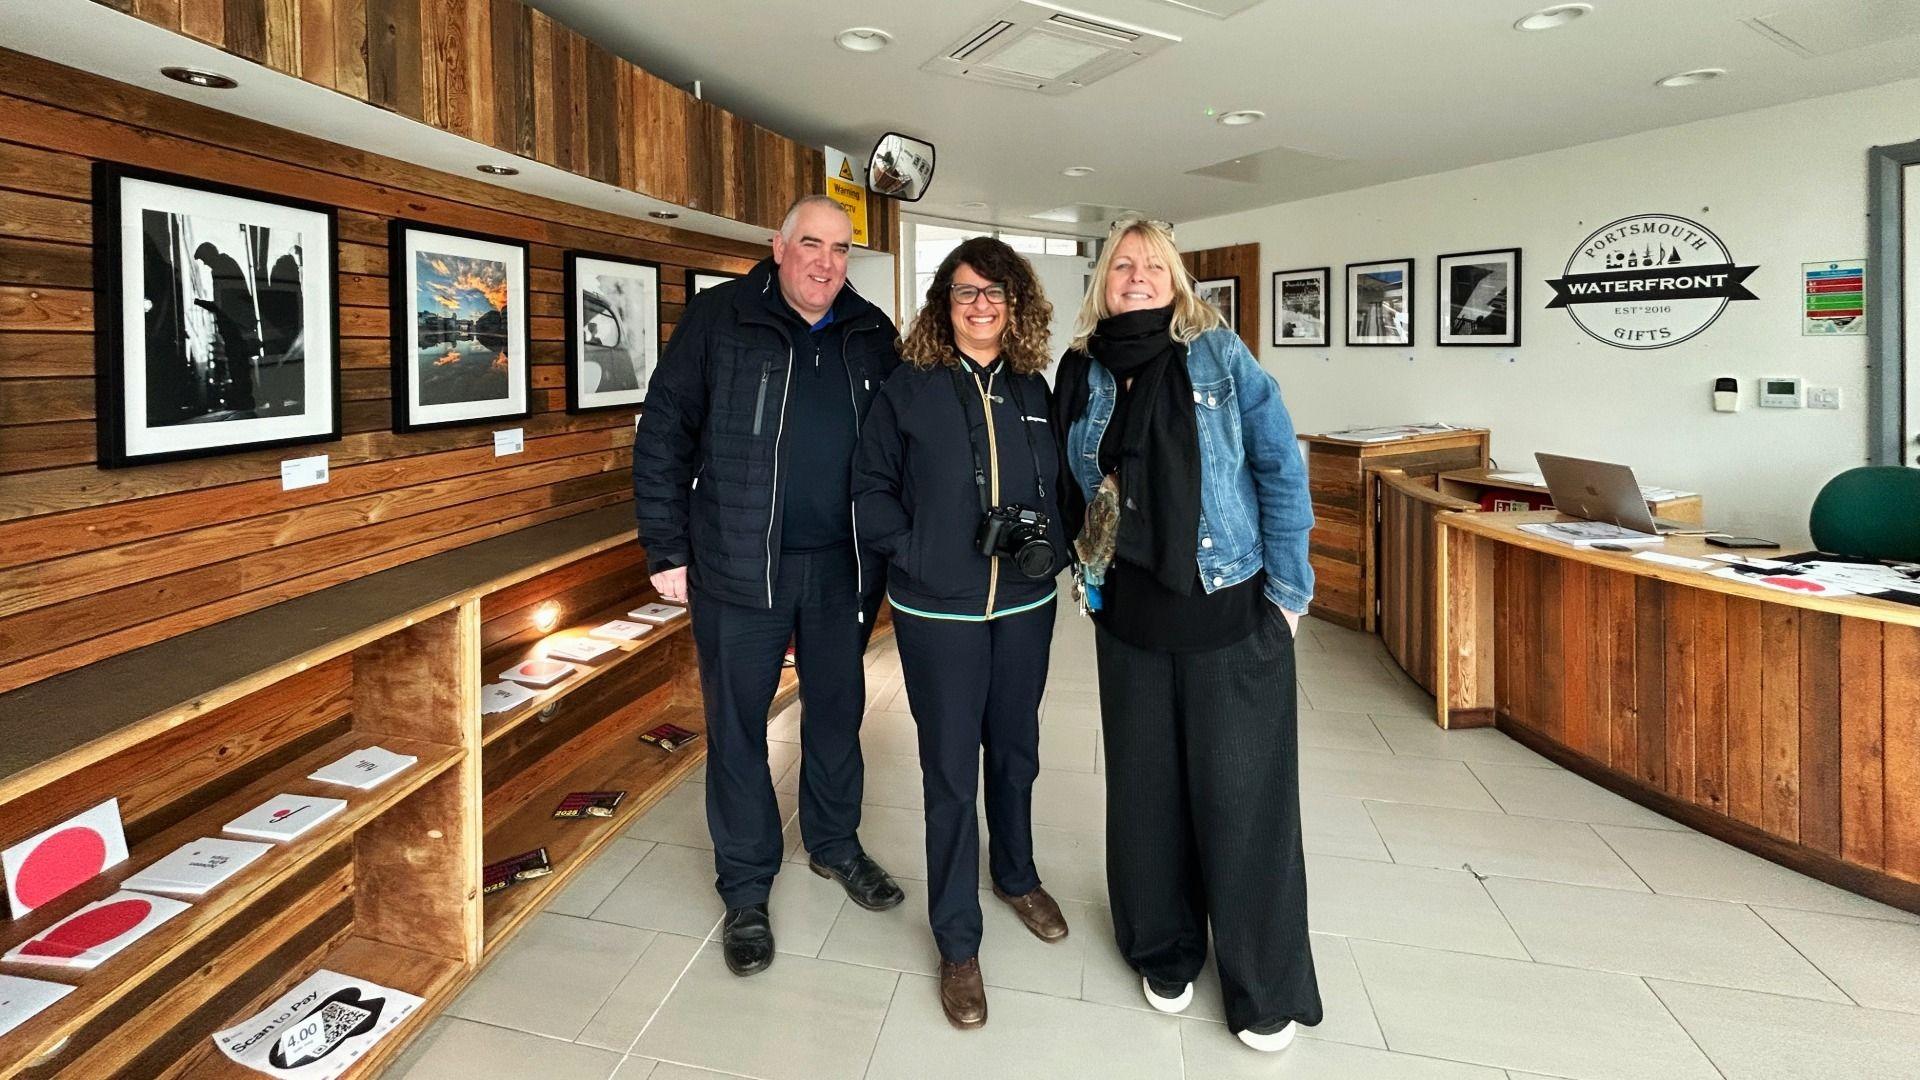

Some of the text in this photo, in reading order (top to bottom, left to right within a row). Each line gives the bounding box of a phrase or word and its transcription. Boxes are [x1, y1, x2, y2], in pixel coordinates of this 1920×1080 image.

[834, 183, 860, 200] Warning
[1584, 222, 1707, 258] PORTSMOUTH
[1567, 273, 1729, 295] WATERFRONT
[1614, 327, 1671, 341] GIFTS
[483, 881, 506, 893] 025
[231, 1023, 276, 1053] Scan
[273, 1012, 292, 1026] to
[292, 990, 319, 1012] Pay
[286, 1022, 318, 1048] 4.00
